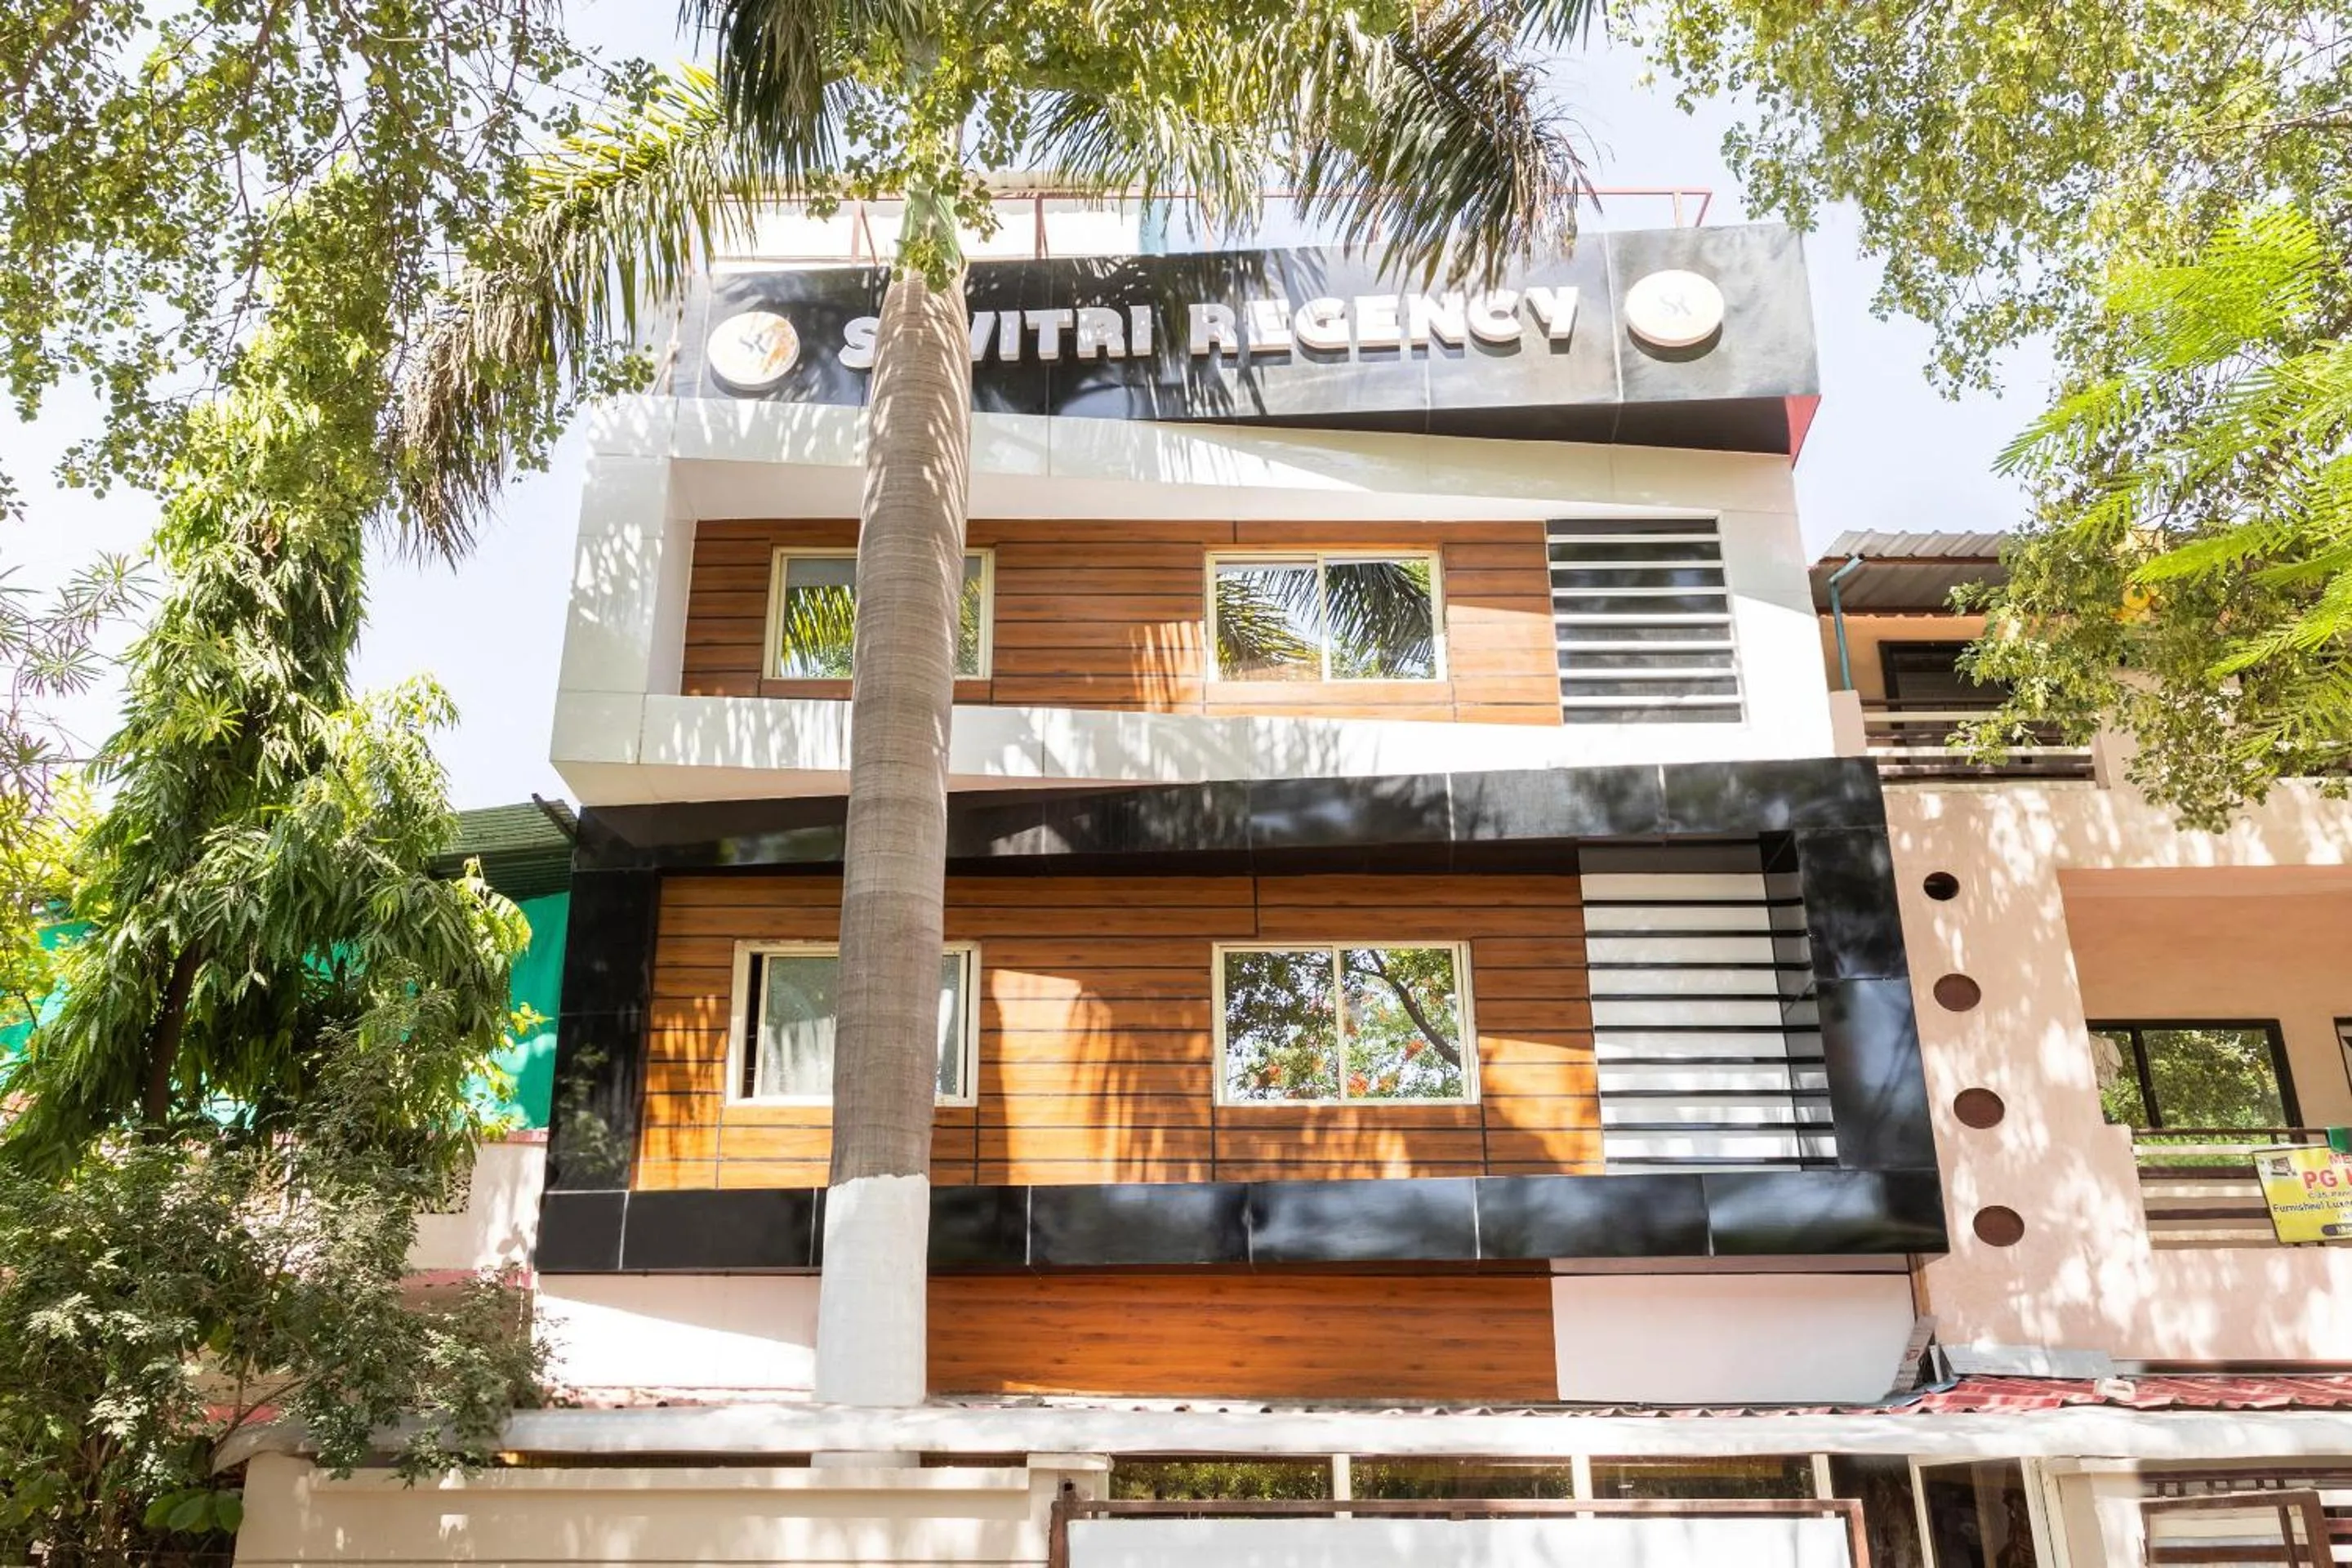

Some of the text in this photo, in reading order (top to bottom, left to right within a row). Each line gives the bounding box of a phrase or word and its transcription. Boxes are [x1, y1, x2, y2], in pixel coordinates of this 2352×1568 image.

[838, 287, 1578, 368] SVITRI REGENCY
[2303, 1170, 2338, 1189] PG
